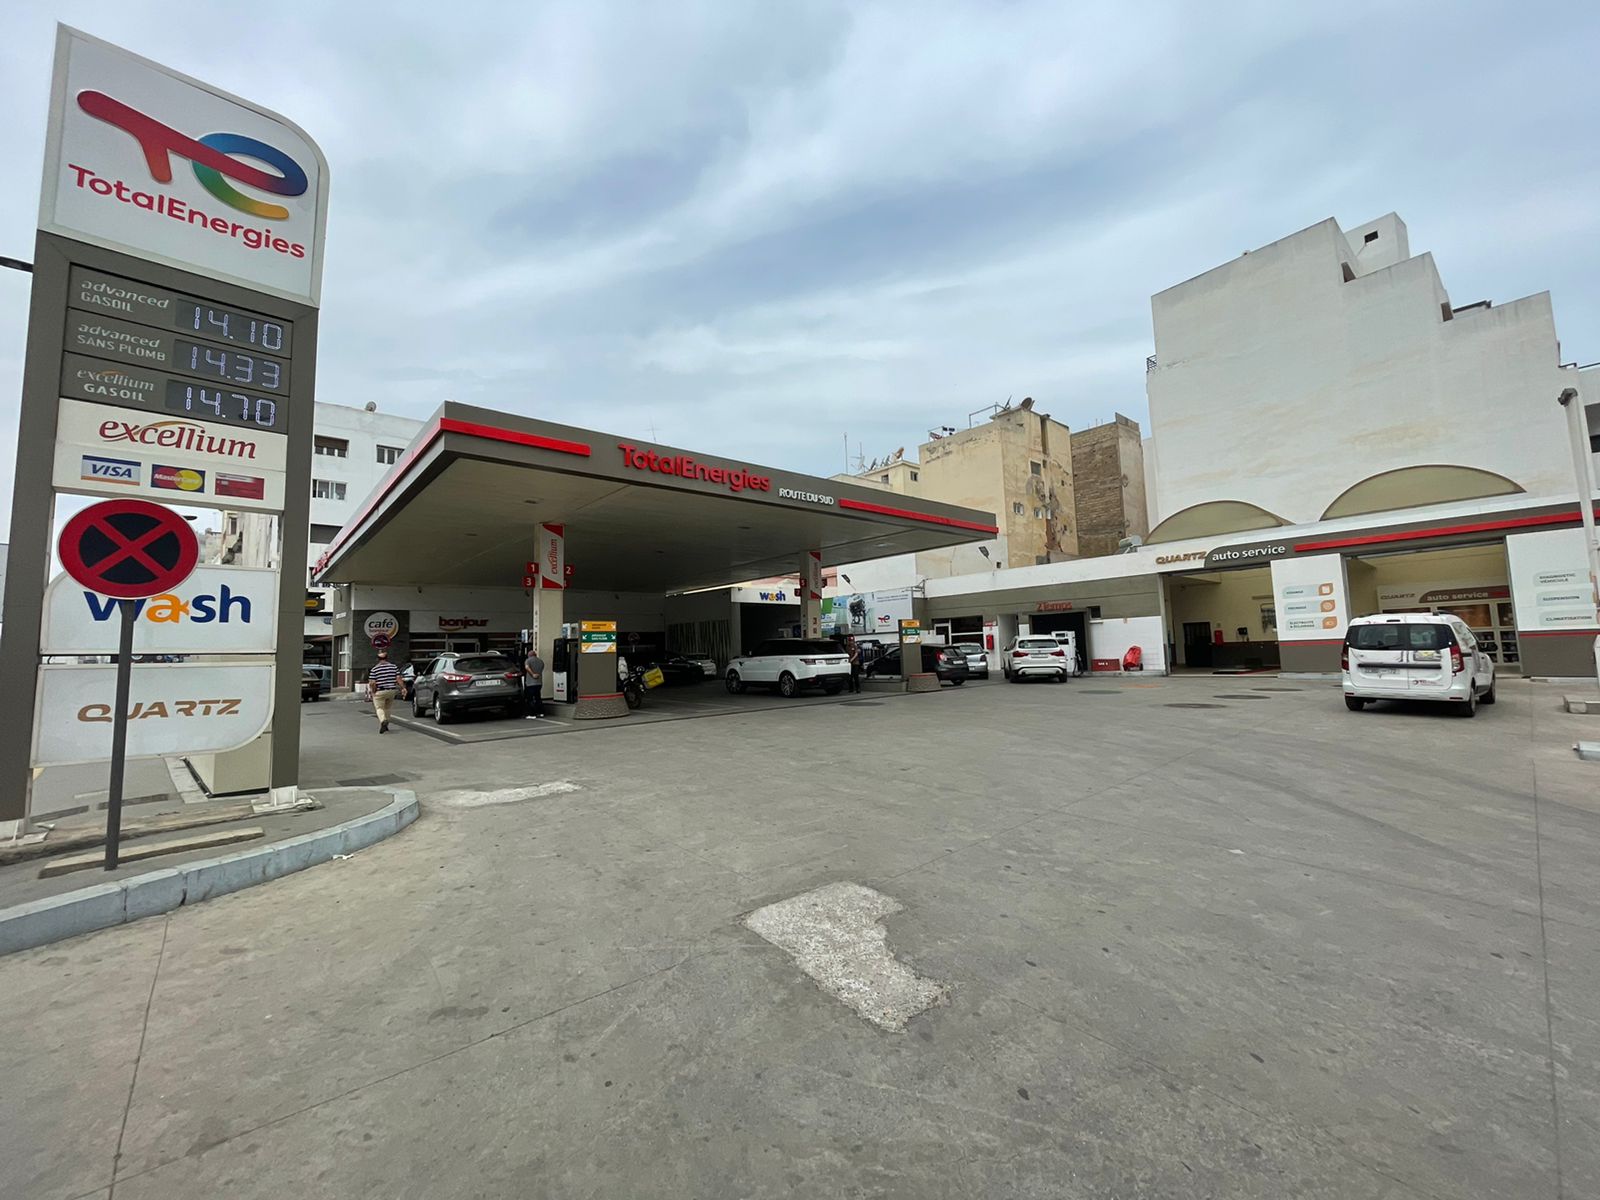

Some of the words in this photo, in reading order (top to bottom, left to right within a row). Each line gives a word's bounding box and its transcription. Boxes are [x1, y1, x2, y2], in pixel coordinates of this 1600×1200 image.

[68, 163, 306, 259] TotalEnergies
[80, 291, 134, 313] GASOIL
[81, 280, 169, 310] advanced
[78, 323, 161, 349] advanced
[194, 306, 282, 350] 14.10
[77, 334, 115, 351] SANS
[119, 343, 167, 362] PLOMB
[191, 346, 280, 390] 14.33
[76, 368, 155, 392] excellium
[83, 383, 146, 402] GASOIL
[185, 386, 276, 427] 14.70
[99, 420, 257, 459] excellium
[91, 463, 133, 479] VISA
[618, 444, 770, 492] TotalEnergies
[778, 487, 806, 501] ROUTE
[806, 492, 818, 502] DU
[818, 494, 834, 505] SUD
[1155, 551, 1207, 565] QUARTZ
[1212, 550, 1240, 561] auto
[1242, 545, 1286, 558] service
[530, 563, 535, 572] 1
[565, 566, 571, 574] 2
[526, 577, 532, 586] 3
[84, 583, 252, 624] wash
[759, 590, 786, 602] wash
[1426, 594, 1449, 602] auto
[1452, 592, 1489, 600] service
[368, 618, 394, 629] café
[439, 616, 490, 629] bonjour
[77, 699, 242, 723] QUARTZ
